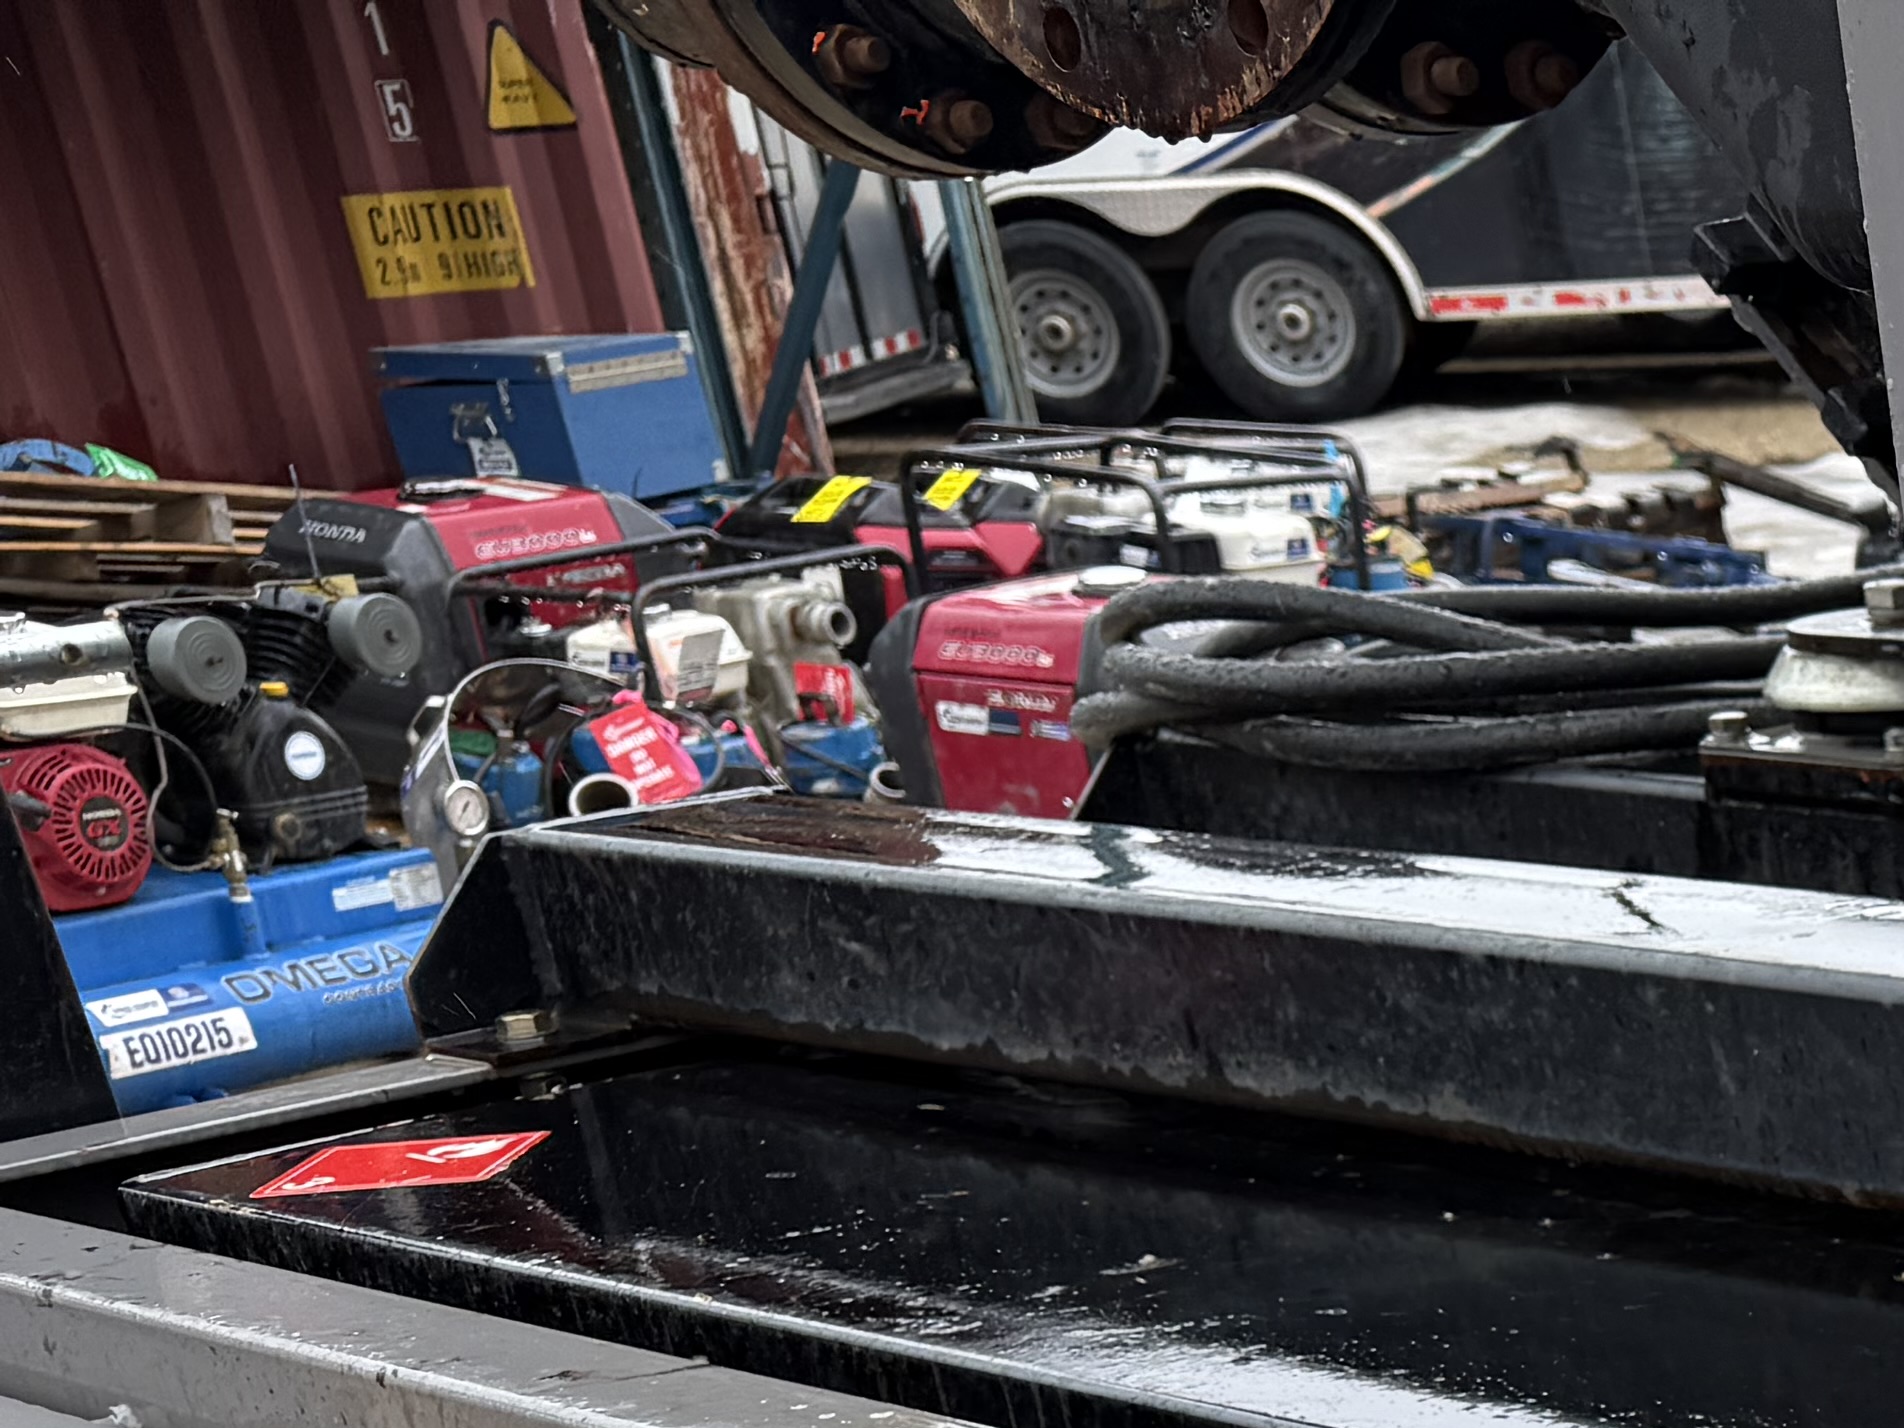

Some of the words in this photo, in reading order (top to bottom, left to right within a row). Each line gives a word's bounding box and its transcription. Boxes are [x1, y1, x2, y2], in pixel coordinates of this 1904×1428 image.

[382, 84, 413, 138] 5
[367, 201, 506, 247] CAUTION
[221, 940, 413, 1006] OMEGA
[121, 1016, 234, 1071] E010215
